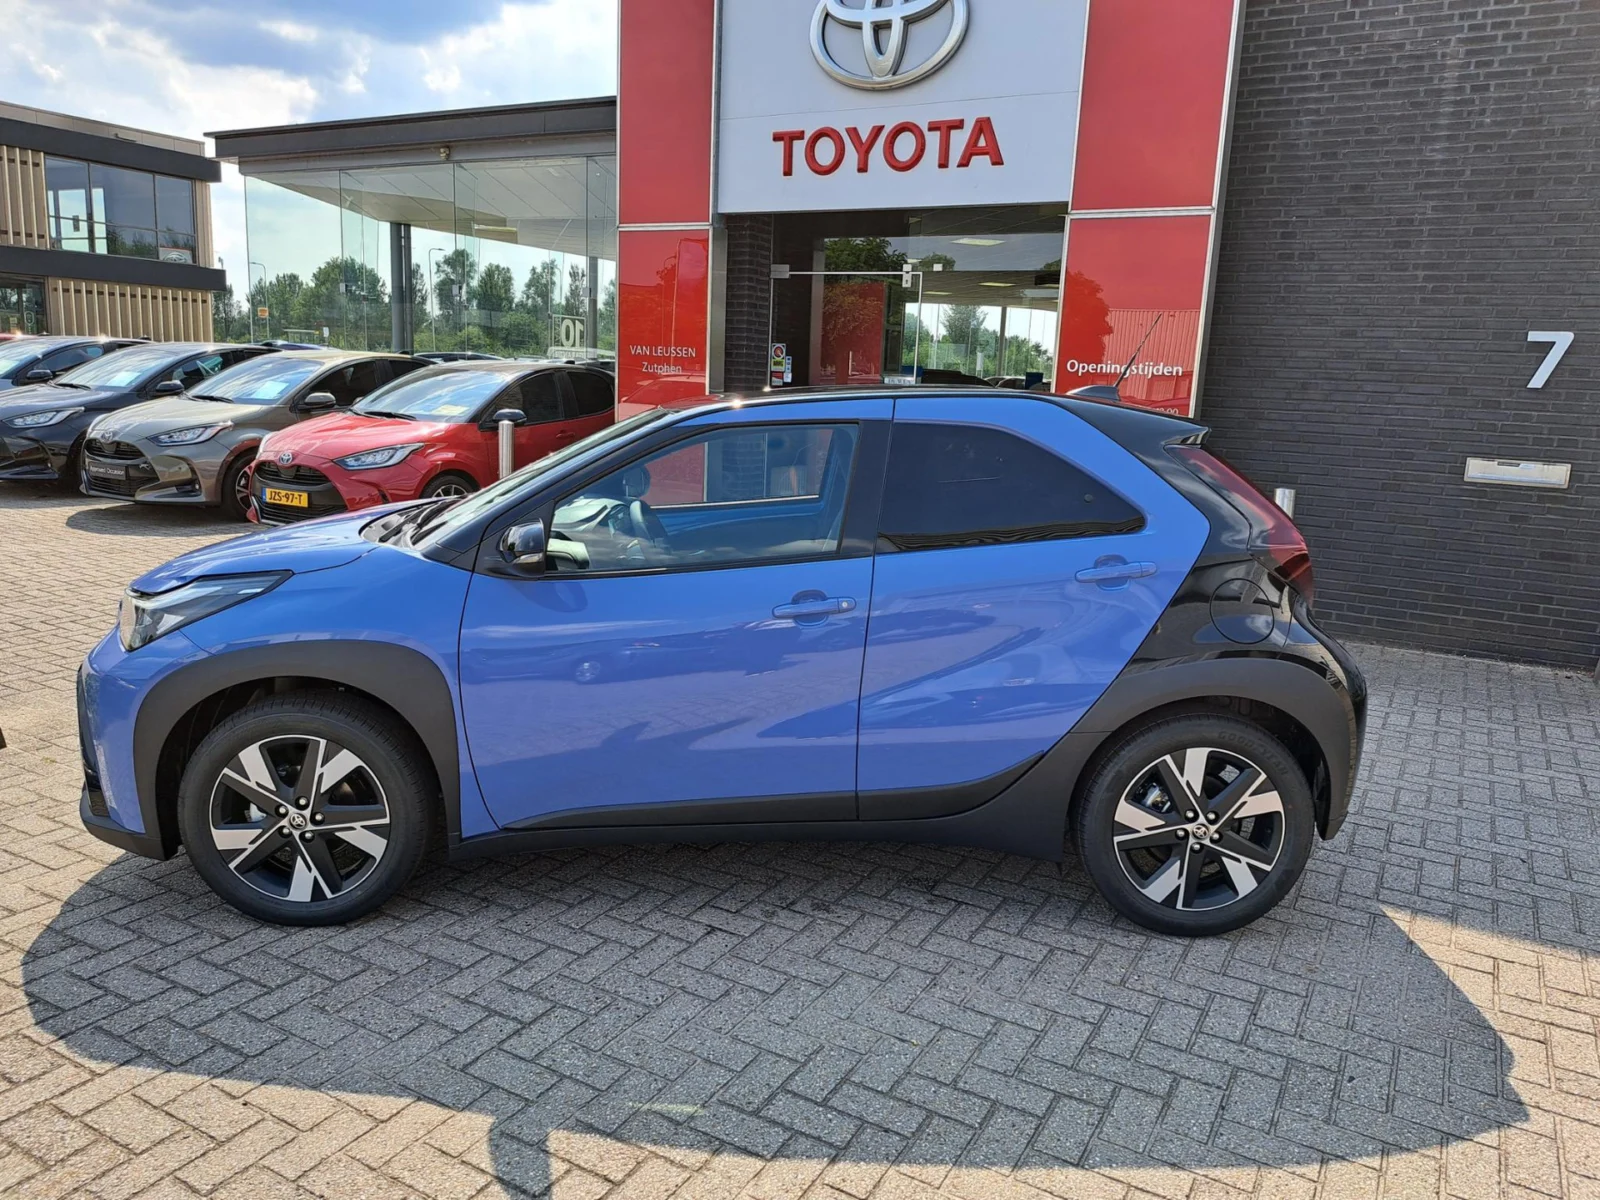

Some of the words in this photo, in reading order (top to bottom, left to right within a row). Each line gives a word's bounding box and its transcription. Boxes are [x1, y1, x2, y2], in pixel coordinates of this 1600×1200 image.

[772, 116, 1004, 177] TOYOTA
[629, 345, 650, 355] VAN
[652, 346, 696, 358] LEUSSEN
[1526, 330, 1575, 389] 7
[642, 361, 682, 375] Zutphen
[1066, 359, 1183, 379] Openingstijden
[269, 489, 303, 505] JZS-97-T
